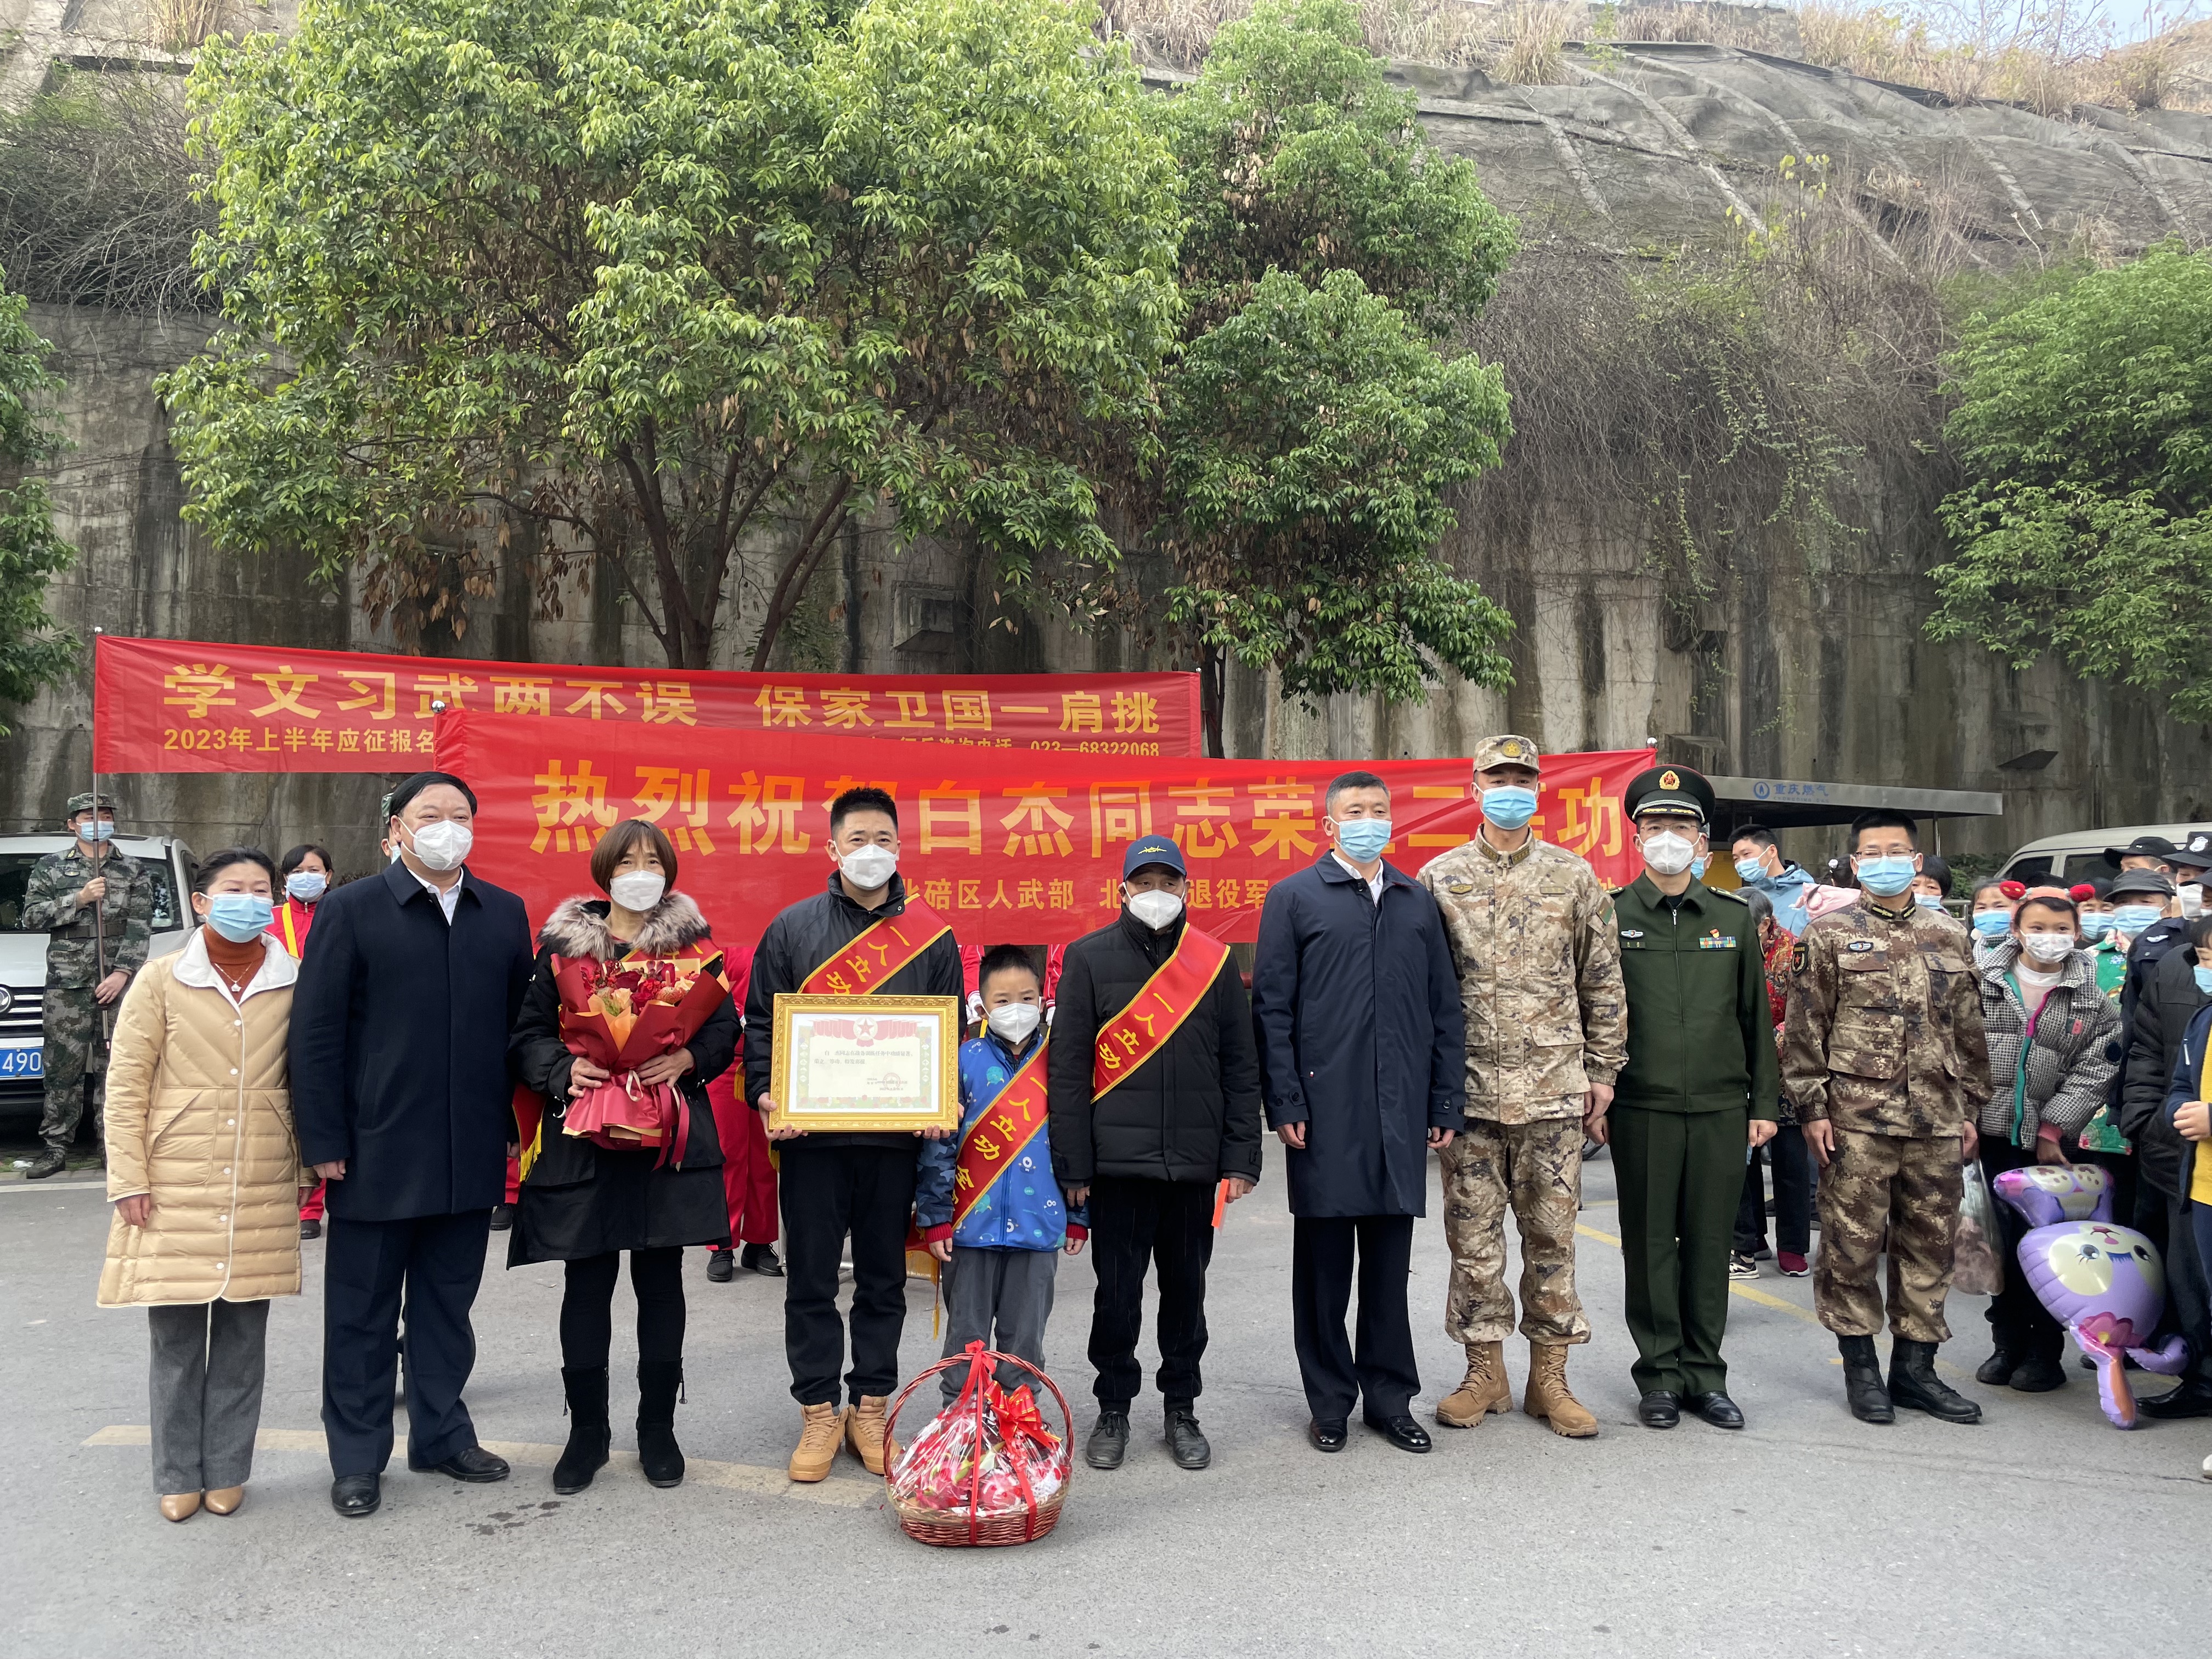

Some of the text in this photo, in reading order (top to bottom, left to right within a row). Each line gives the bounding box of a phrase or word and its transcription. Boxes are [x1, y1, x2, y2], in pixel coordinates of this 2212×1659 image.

[163, 663, 1159, 735] 学文习武两不误 保家卫国一肩挑
[163, 726, 435, 754] 2023年上半年应征报名
[529, 759, 1622, 859] 热烈祝白杰同志荣二功
[1774, 783, 1829, 797] 重庆燃气
[826, 926, 911, 995] 一人立功
[0, 1052, 41, 1073] 490
[1099, 992, 1175, 1069] 一人立功
